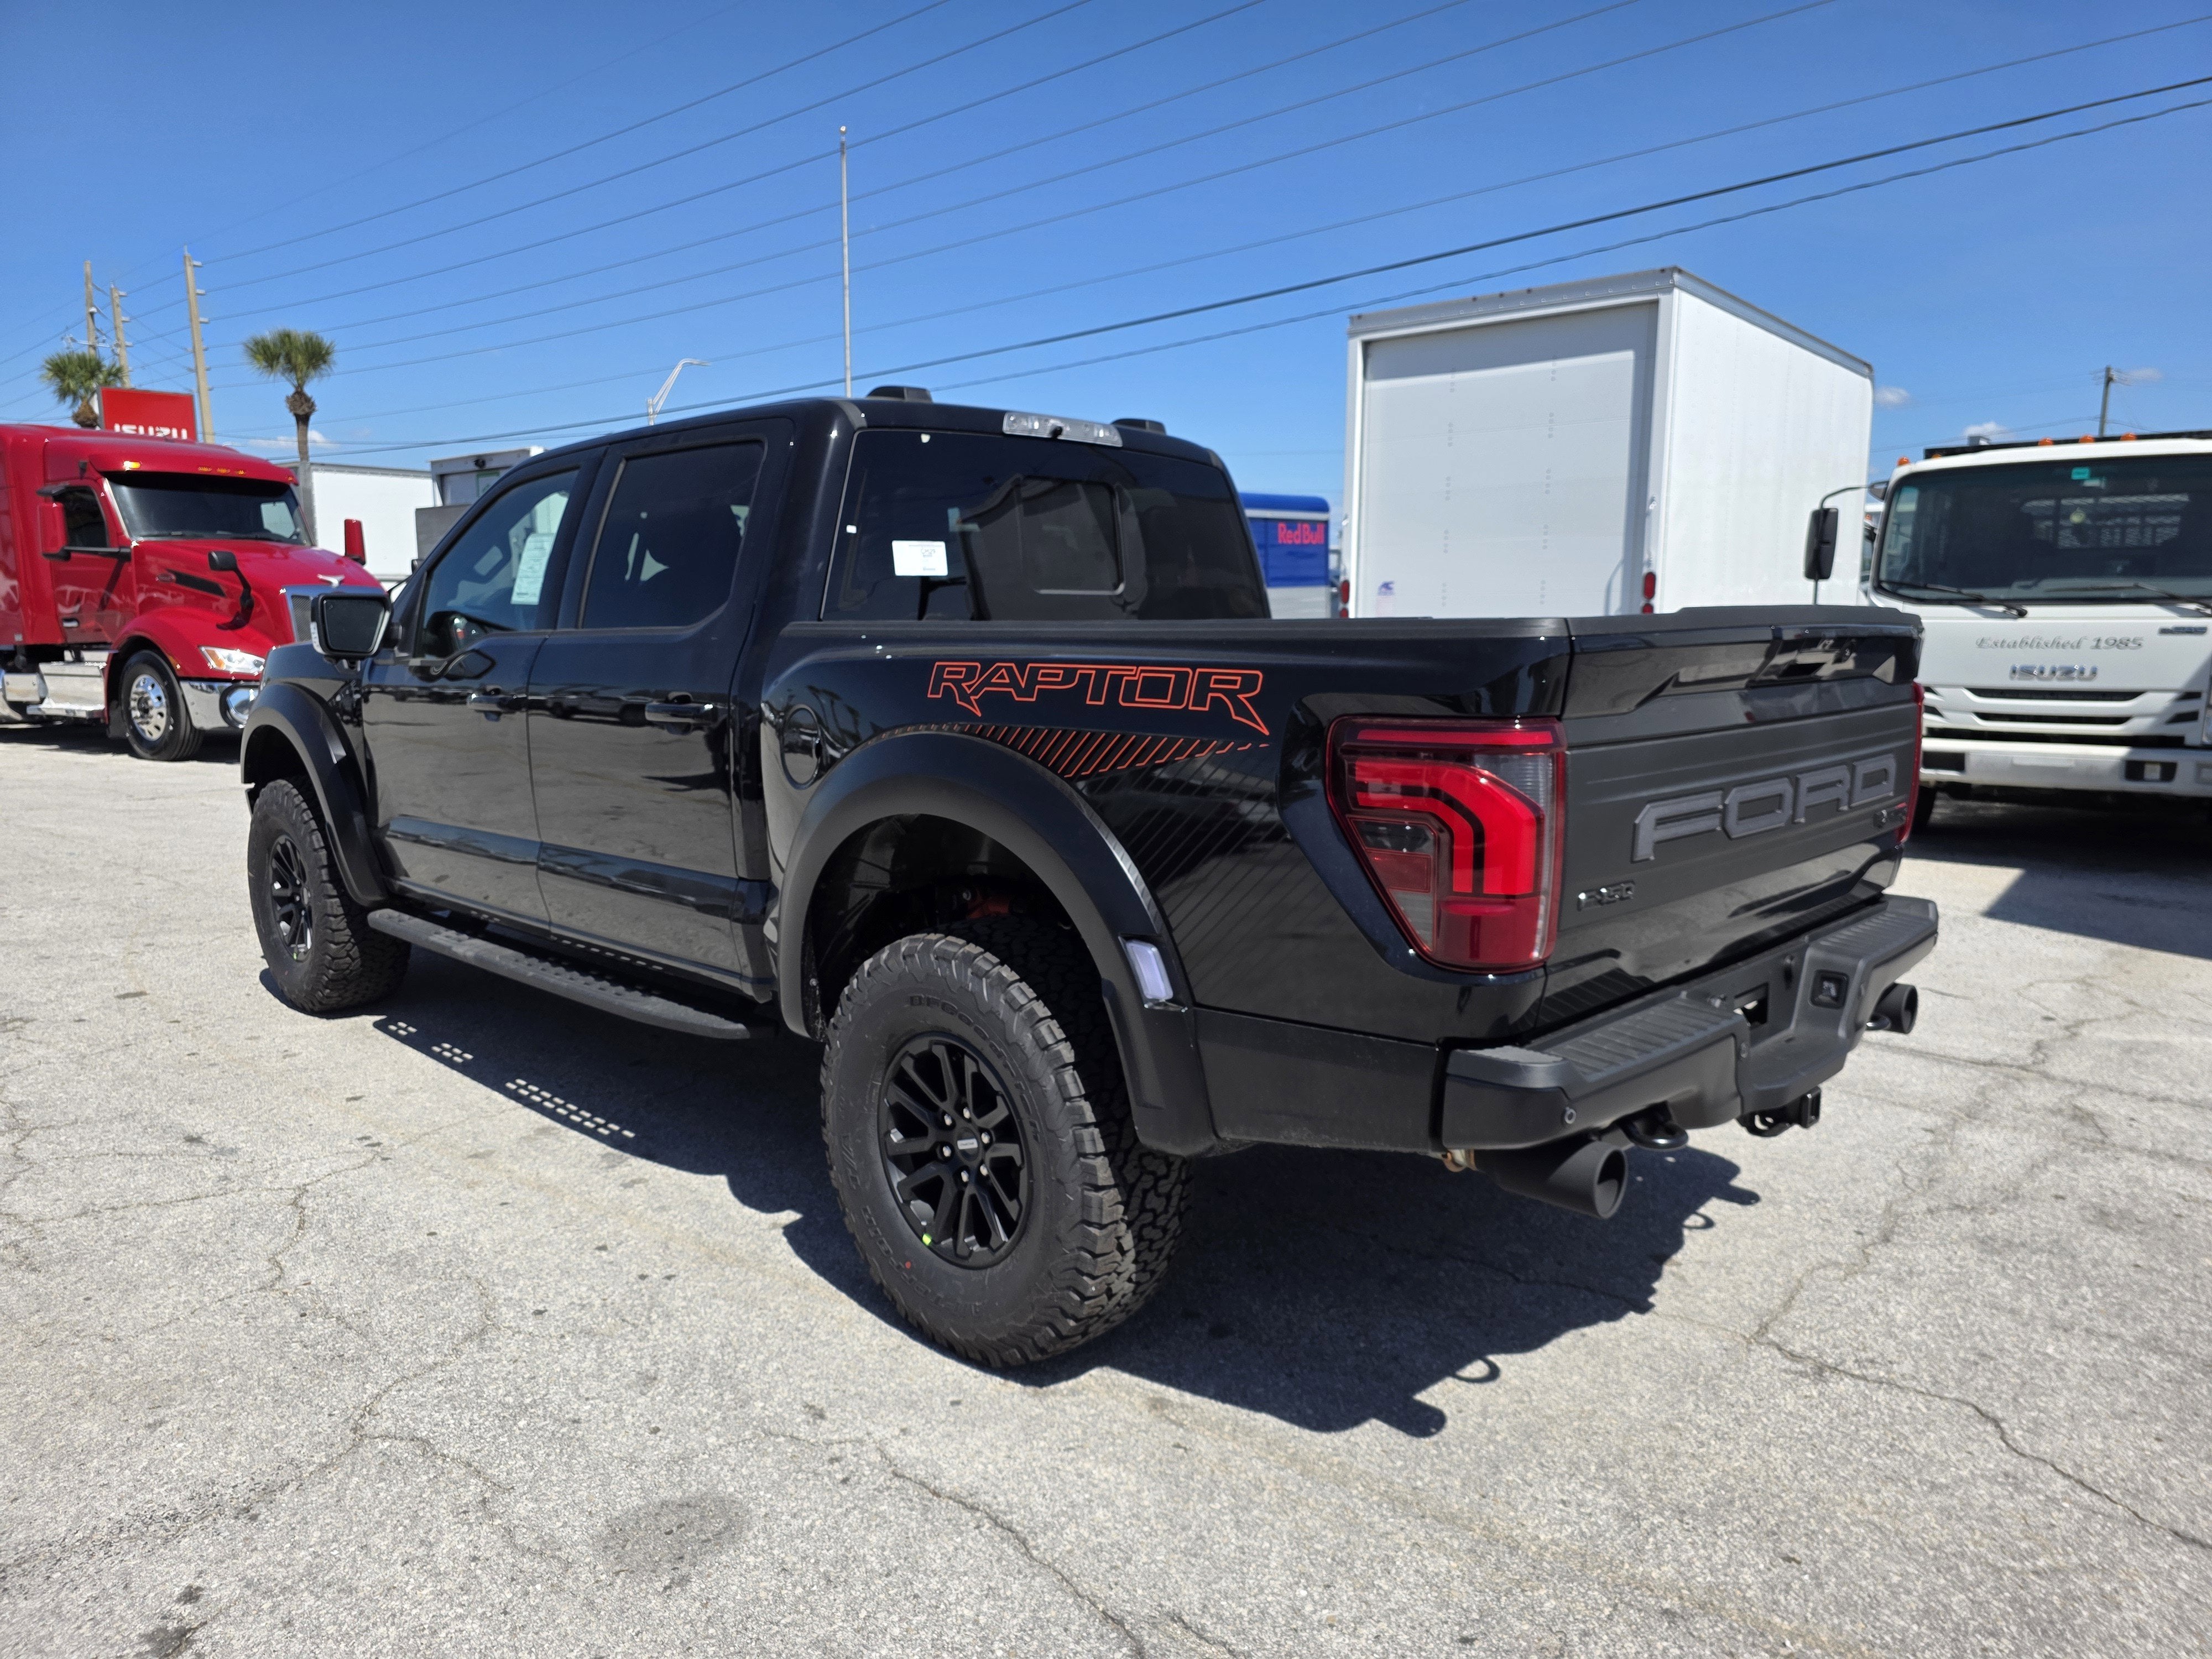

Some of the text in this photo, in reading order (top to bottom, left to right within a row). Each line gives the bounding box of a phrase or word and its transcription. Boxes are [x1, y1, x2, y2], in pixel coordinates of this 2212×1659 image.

[1976, 635, 2143, 650] Established 1985
[2010, 664, 2098, 681] ISUZU
[927, 662, 1269, 735] RAPTOR
[1631, 754, 1896, 863] FORD
